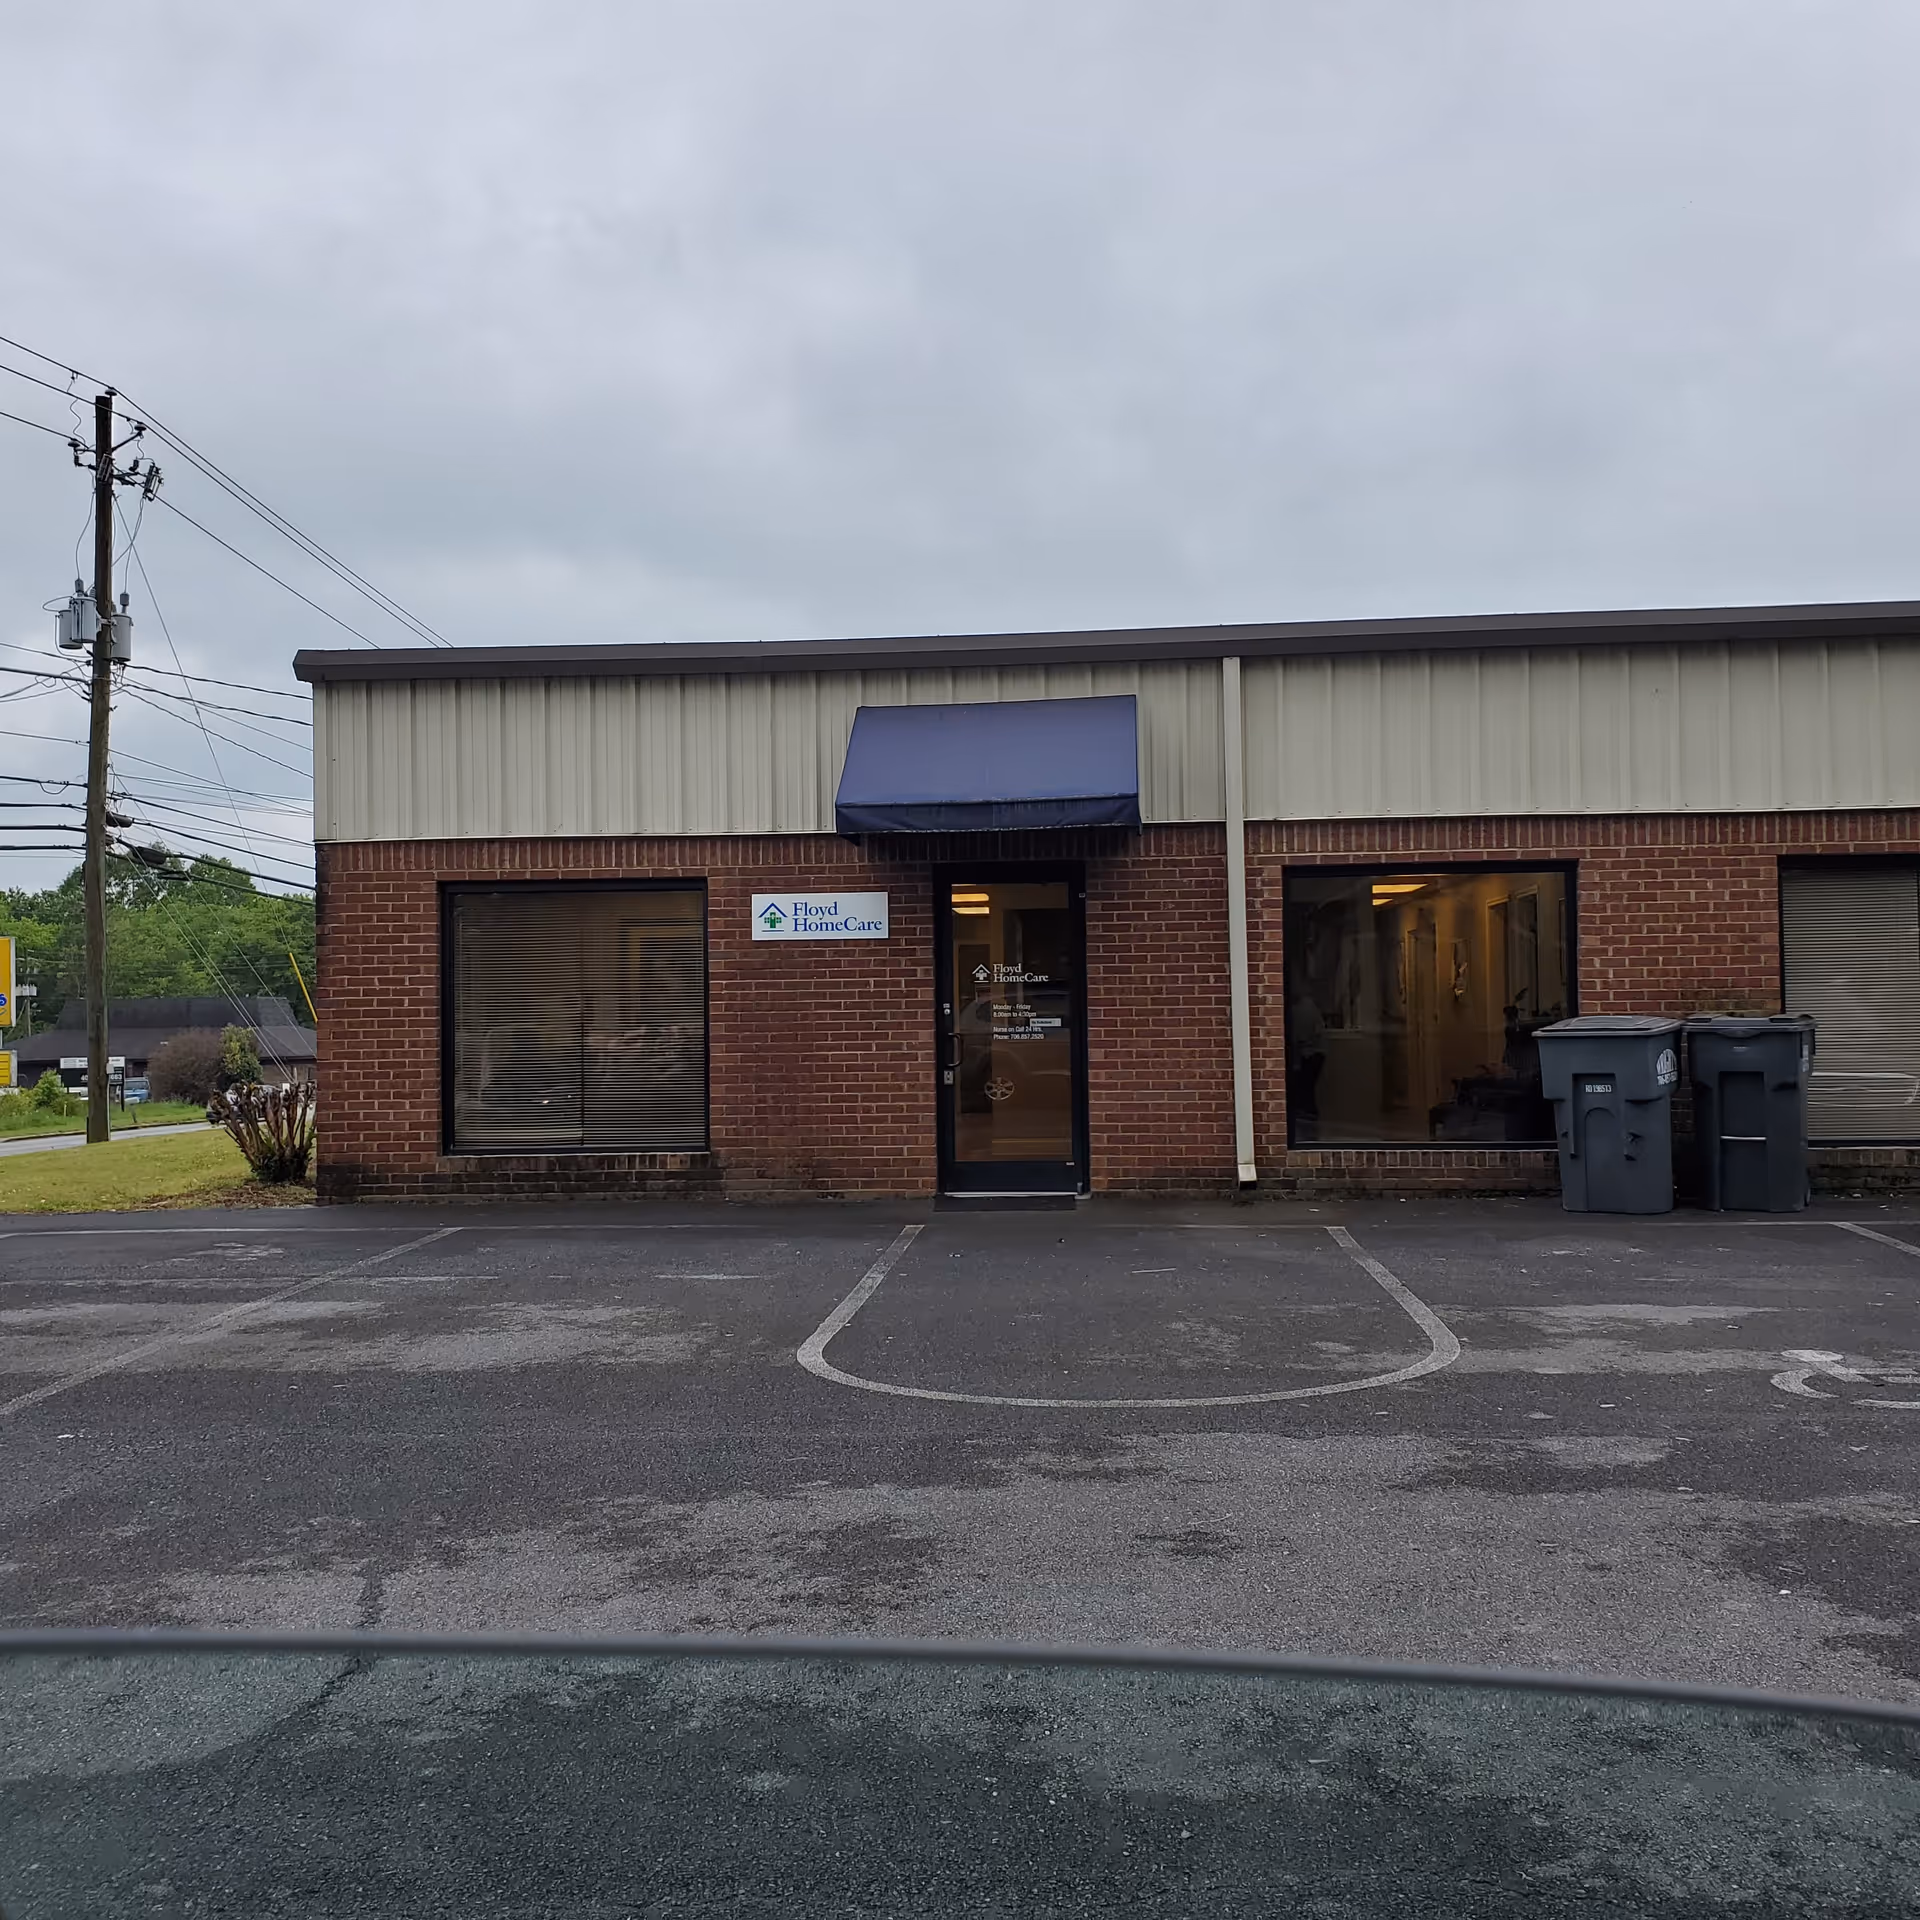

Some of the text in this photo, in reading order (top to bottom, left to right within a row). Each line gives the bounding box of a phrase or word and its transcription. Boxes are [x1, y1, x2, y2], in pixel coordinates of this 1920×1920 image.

[792, 901, 839, 920] Floyd
[792, 916, 883, 932] HomeCare
[993, 963, 1022, 975] Floyd
[993, 972, 1049, 983] HomeCare
